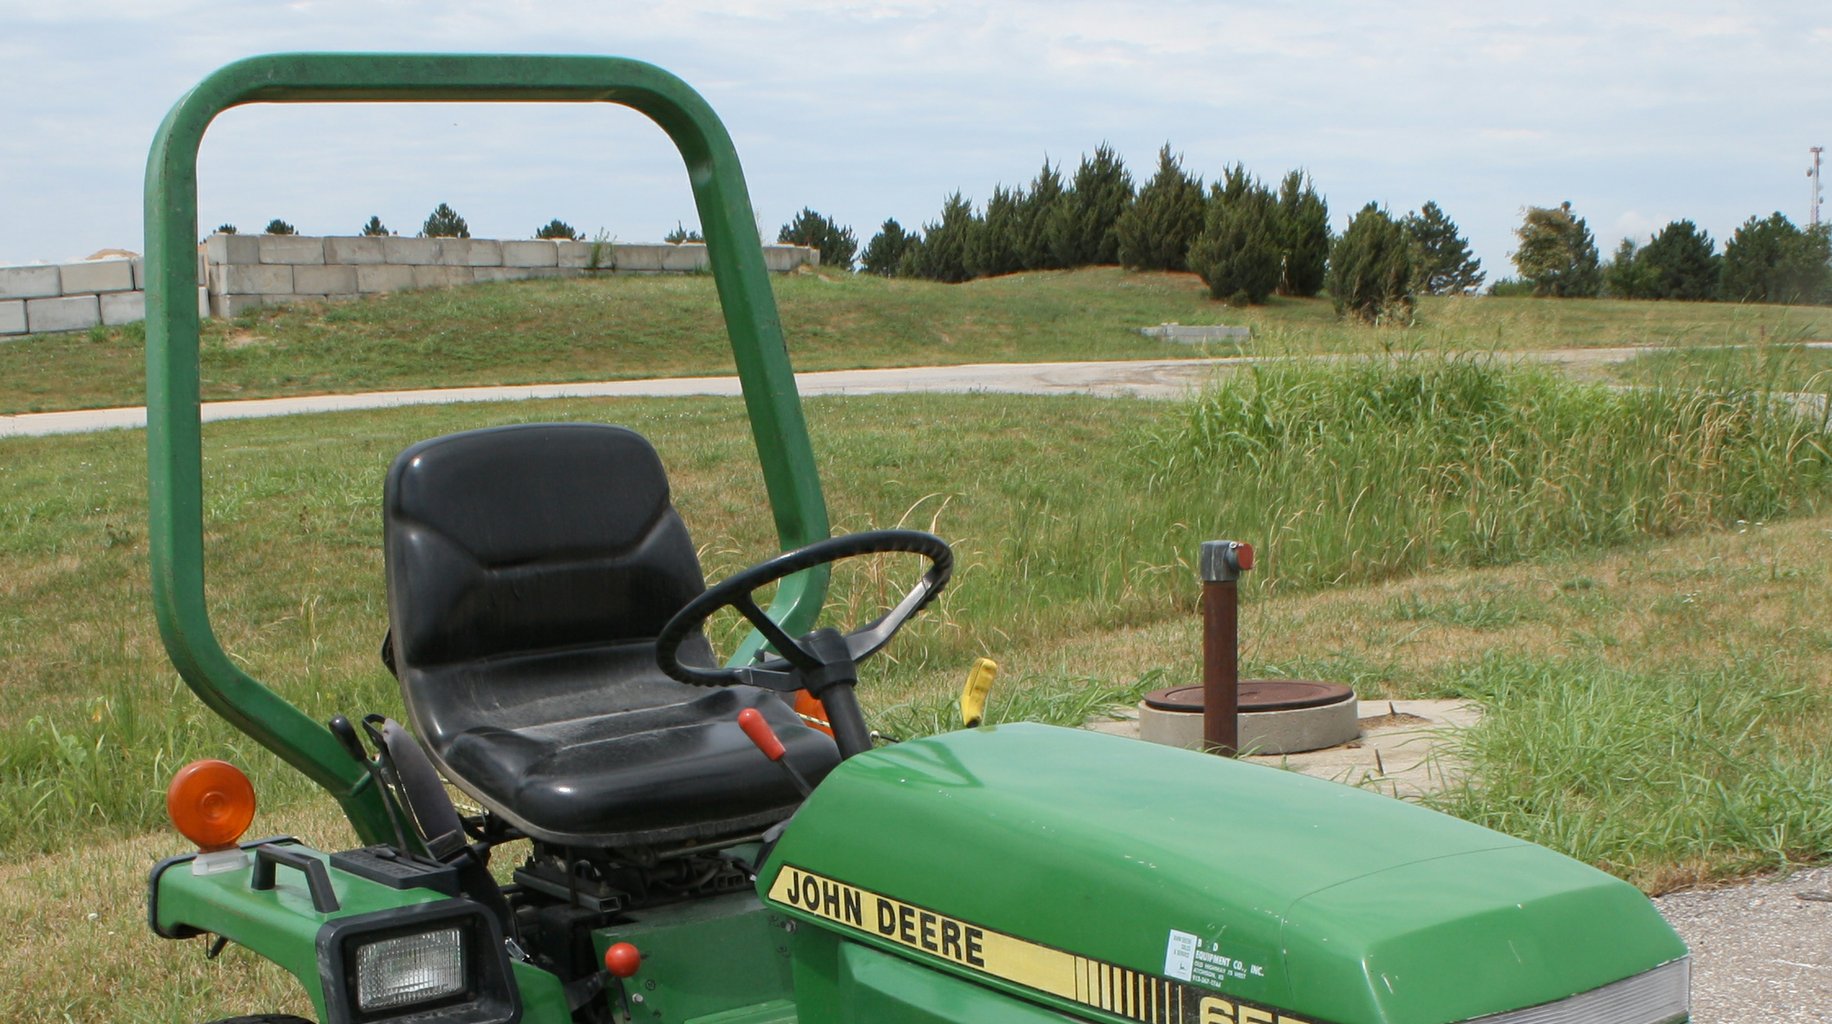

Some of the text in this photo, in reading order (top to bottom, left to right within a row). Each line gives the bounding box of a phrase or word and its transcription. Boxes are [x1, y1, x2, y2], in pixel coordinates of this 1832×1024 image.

[787, 869, 986, 968] JOHN DEERE
[1195, 950, 1231, 967] EQUIPMENT
[1250, 964, 1264, 977] INC.
